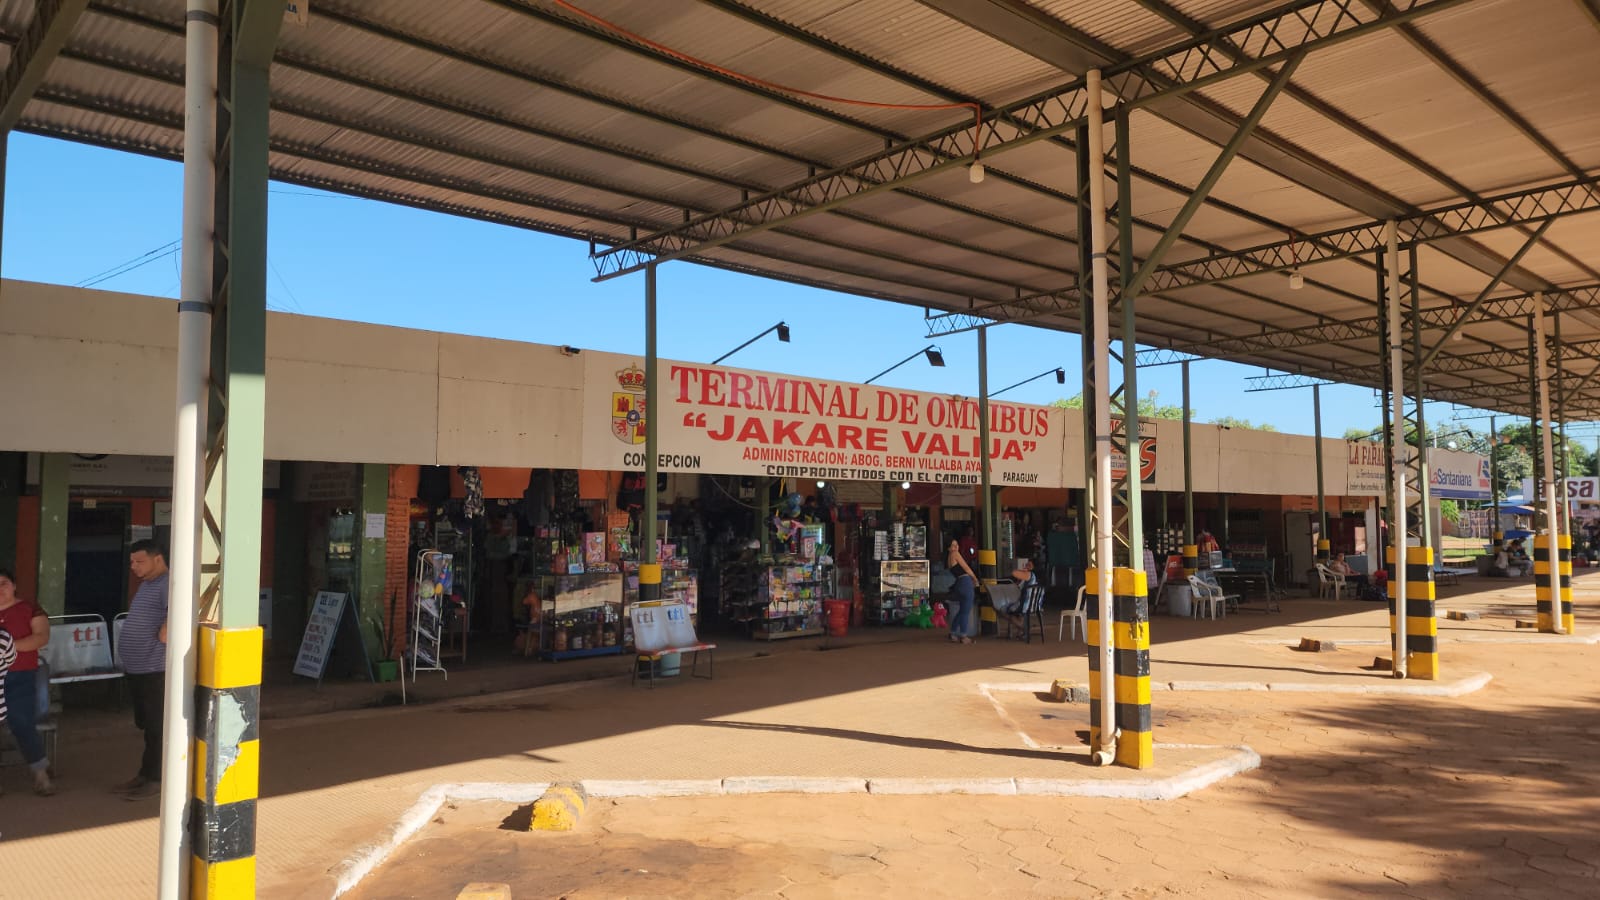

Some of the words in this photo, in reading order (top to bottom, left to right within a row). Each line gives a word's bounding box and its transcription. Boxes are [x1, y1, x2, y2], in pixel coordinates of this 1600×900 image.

[671, 365, 868, 420] TERMINAL
[876, 390, 919, 425] DE
[926, 396, 1049, 437] OMNIBUS
[623, 452, 701, 468] CONEPCION
[743, 446, 848, 465] ADMINISTRACION:
[851, 453, 882, 468] ABOG.
[886, 455, 915, 469] BERNI
[918, 458, 962, 472] VILLALBA
[918, 472, 931, 482] EL
[1003, 471, 1039, 484] PARAGUAY
